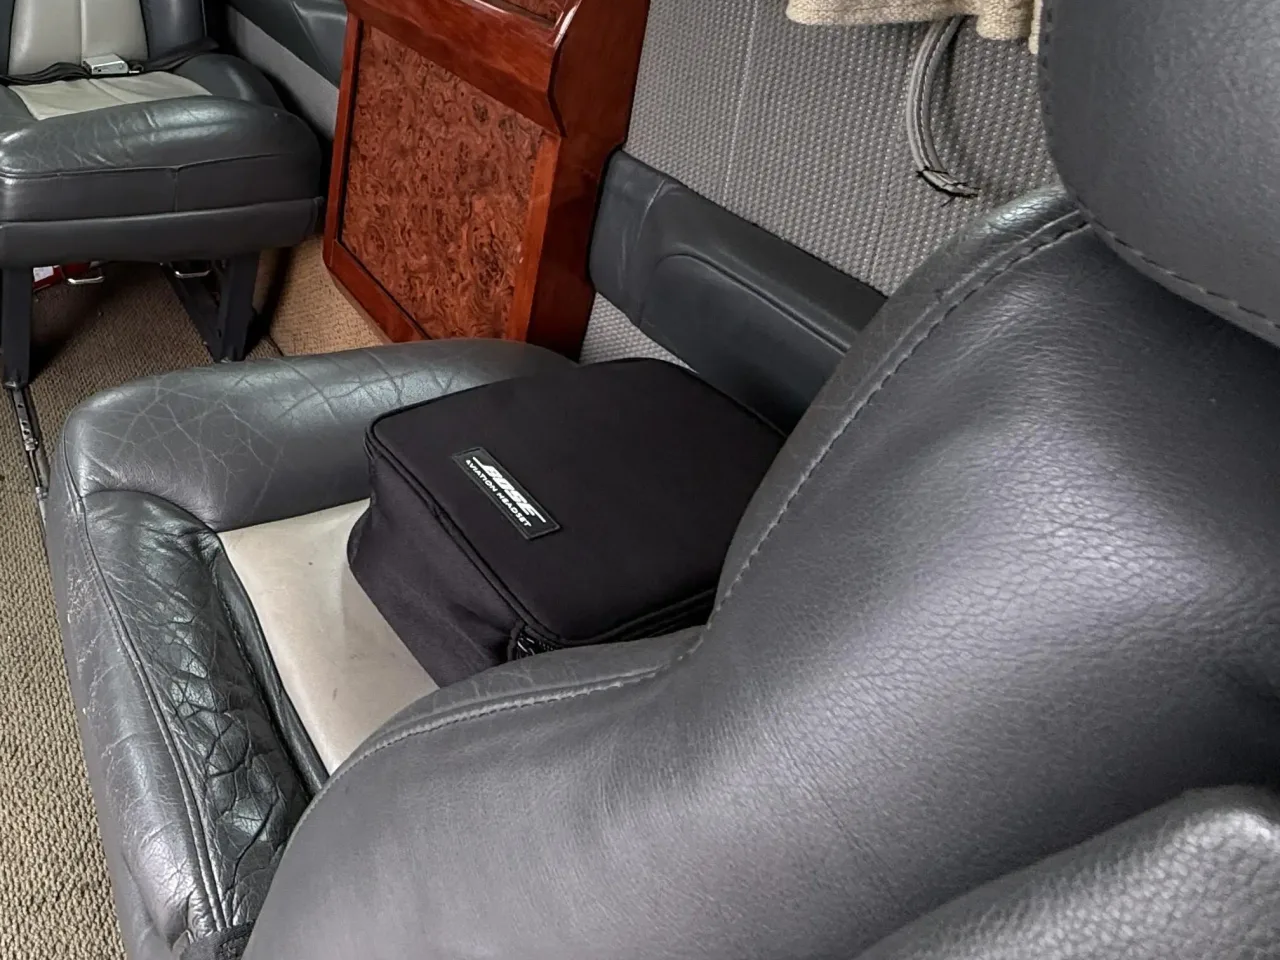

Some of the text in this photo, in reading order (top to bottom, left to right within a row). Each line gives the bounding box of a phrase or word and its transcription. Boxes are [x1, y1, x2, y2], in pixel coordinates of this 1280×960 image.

[465, 459, 532, 528] AVIATION HEADSET
[472, 456, 546, 524] BOSE
